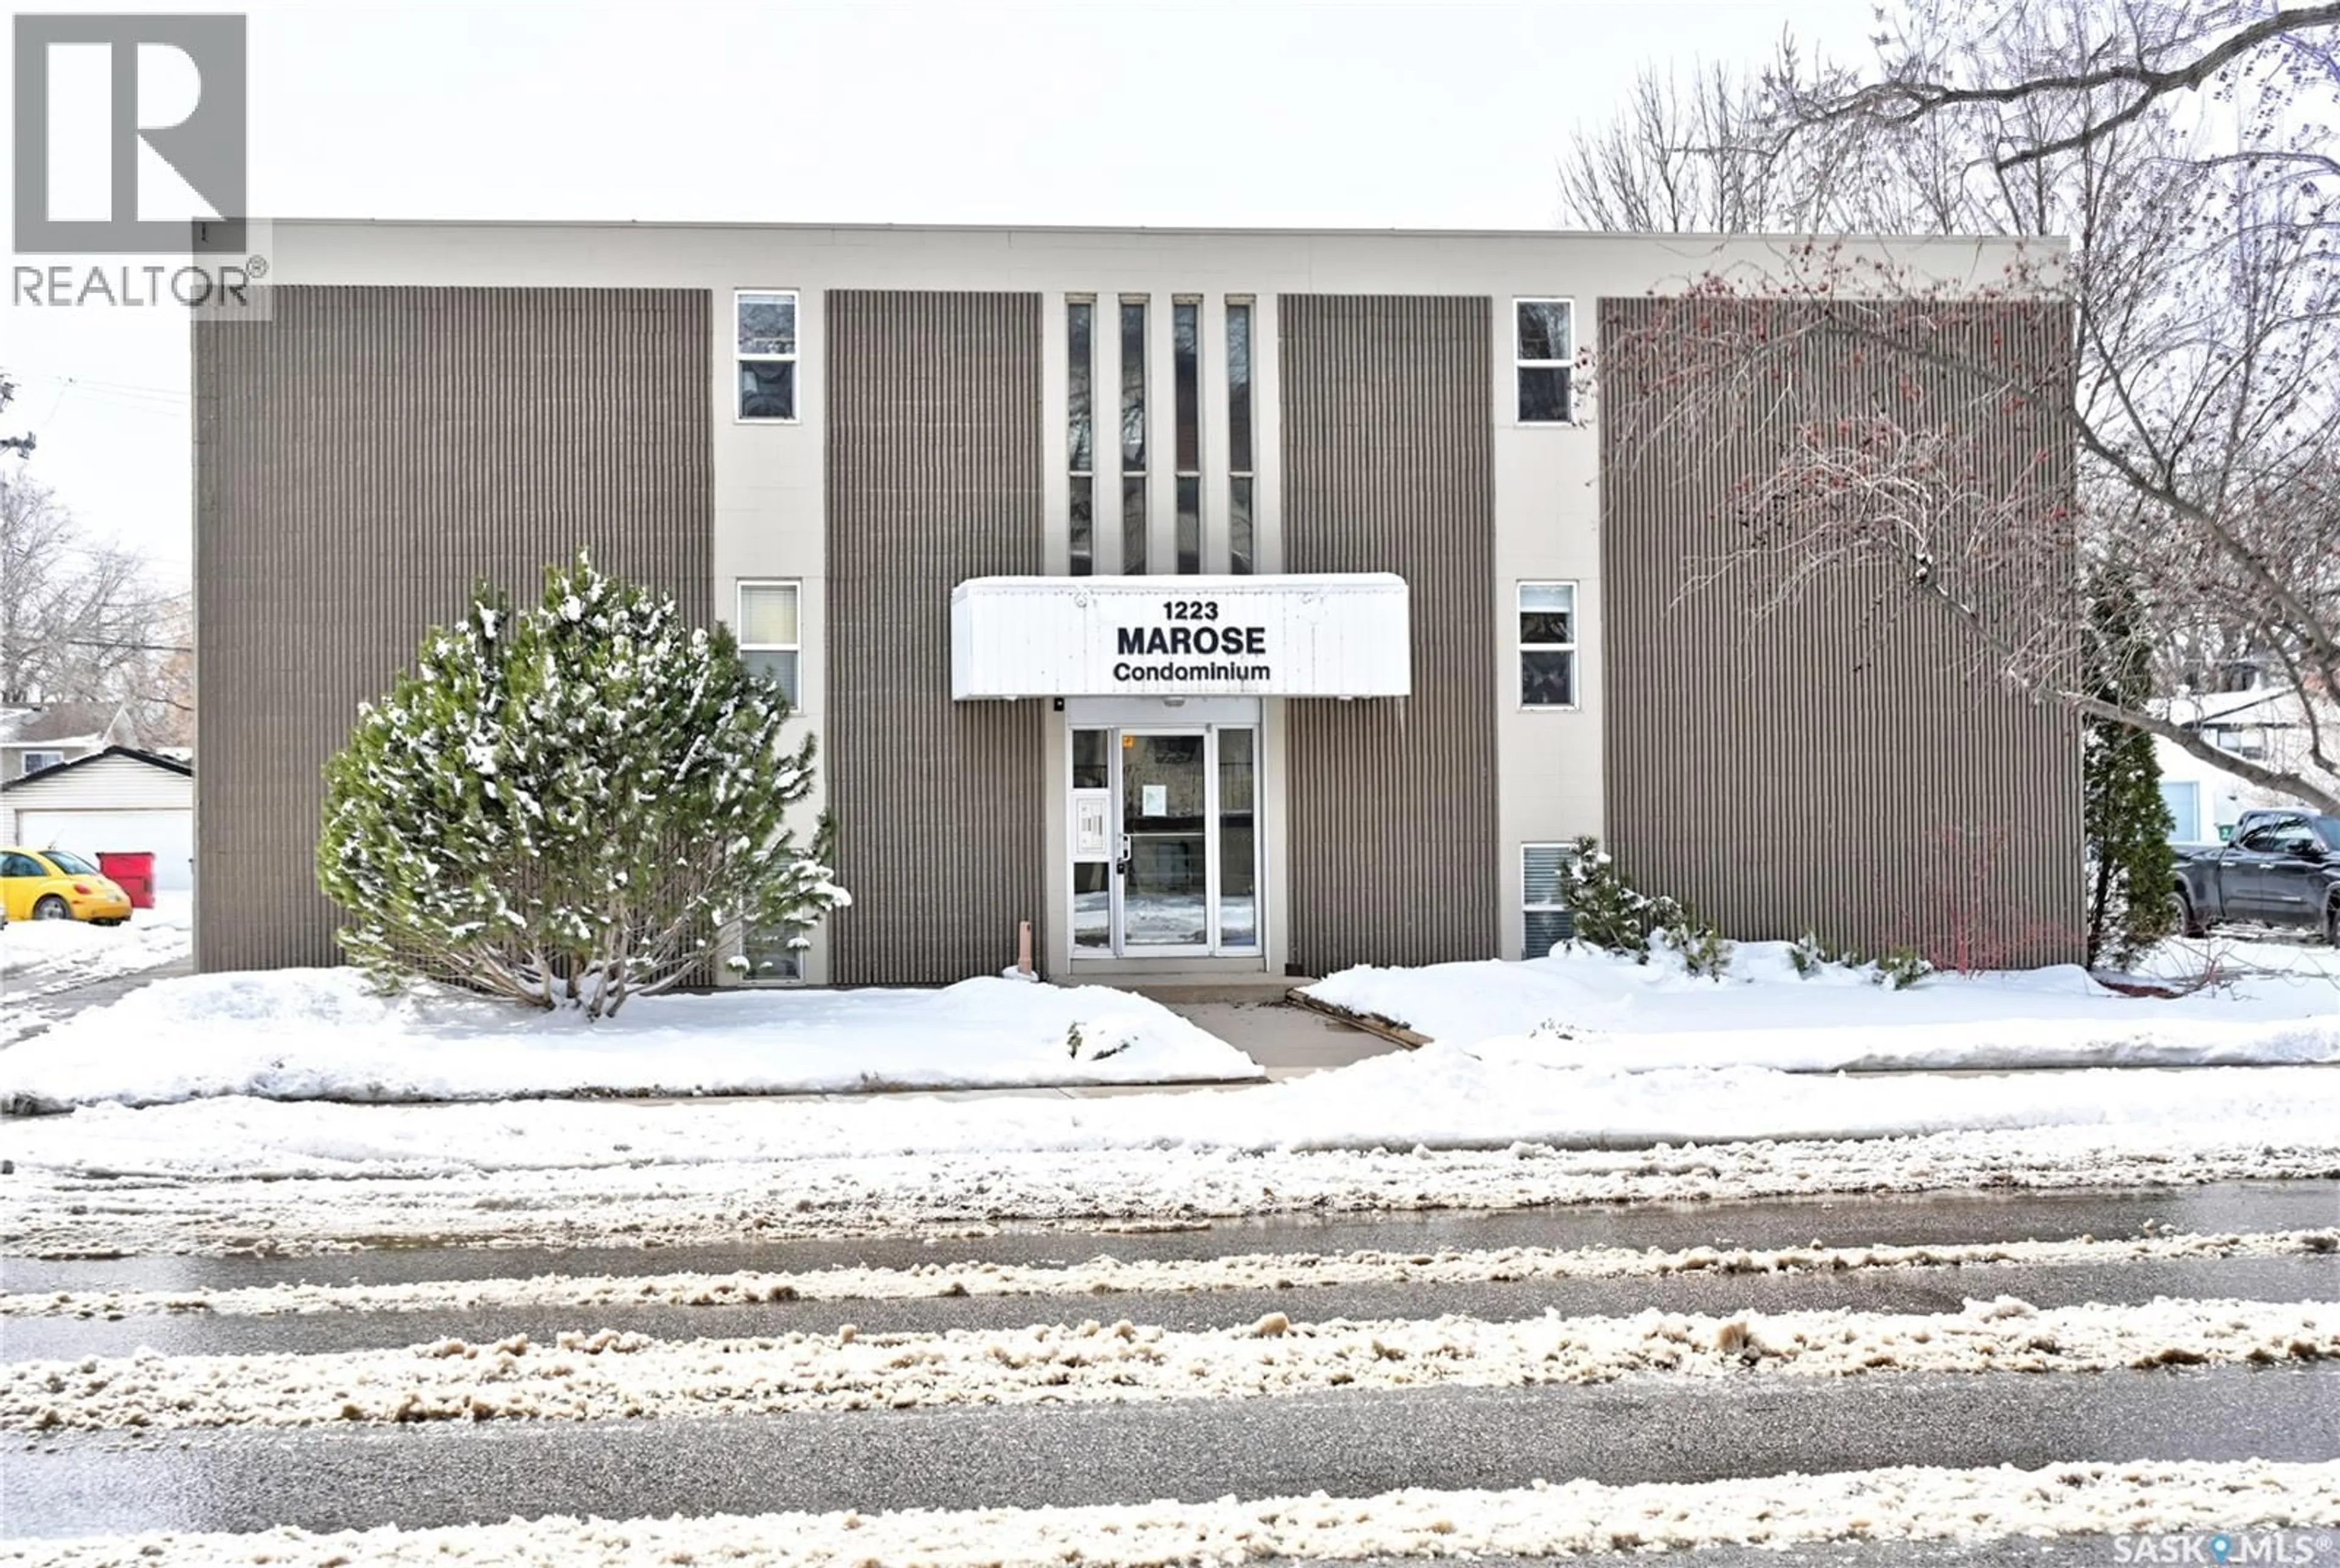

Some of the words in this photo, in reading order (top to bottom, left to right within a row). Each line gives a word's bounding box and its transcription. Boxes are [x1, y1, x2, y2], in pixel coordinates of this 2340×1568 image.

[1163, 601, 1219, 620] 1223
[1117, 626, 1266, 655] MAROSE
[1113, 662, 1271, 681] Condominium
